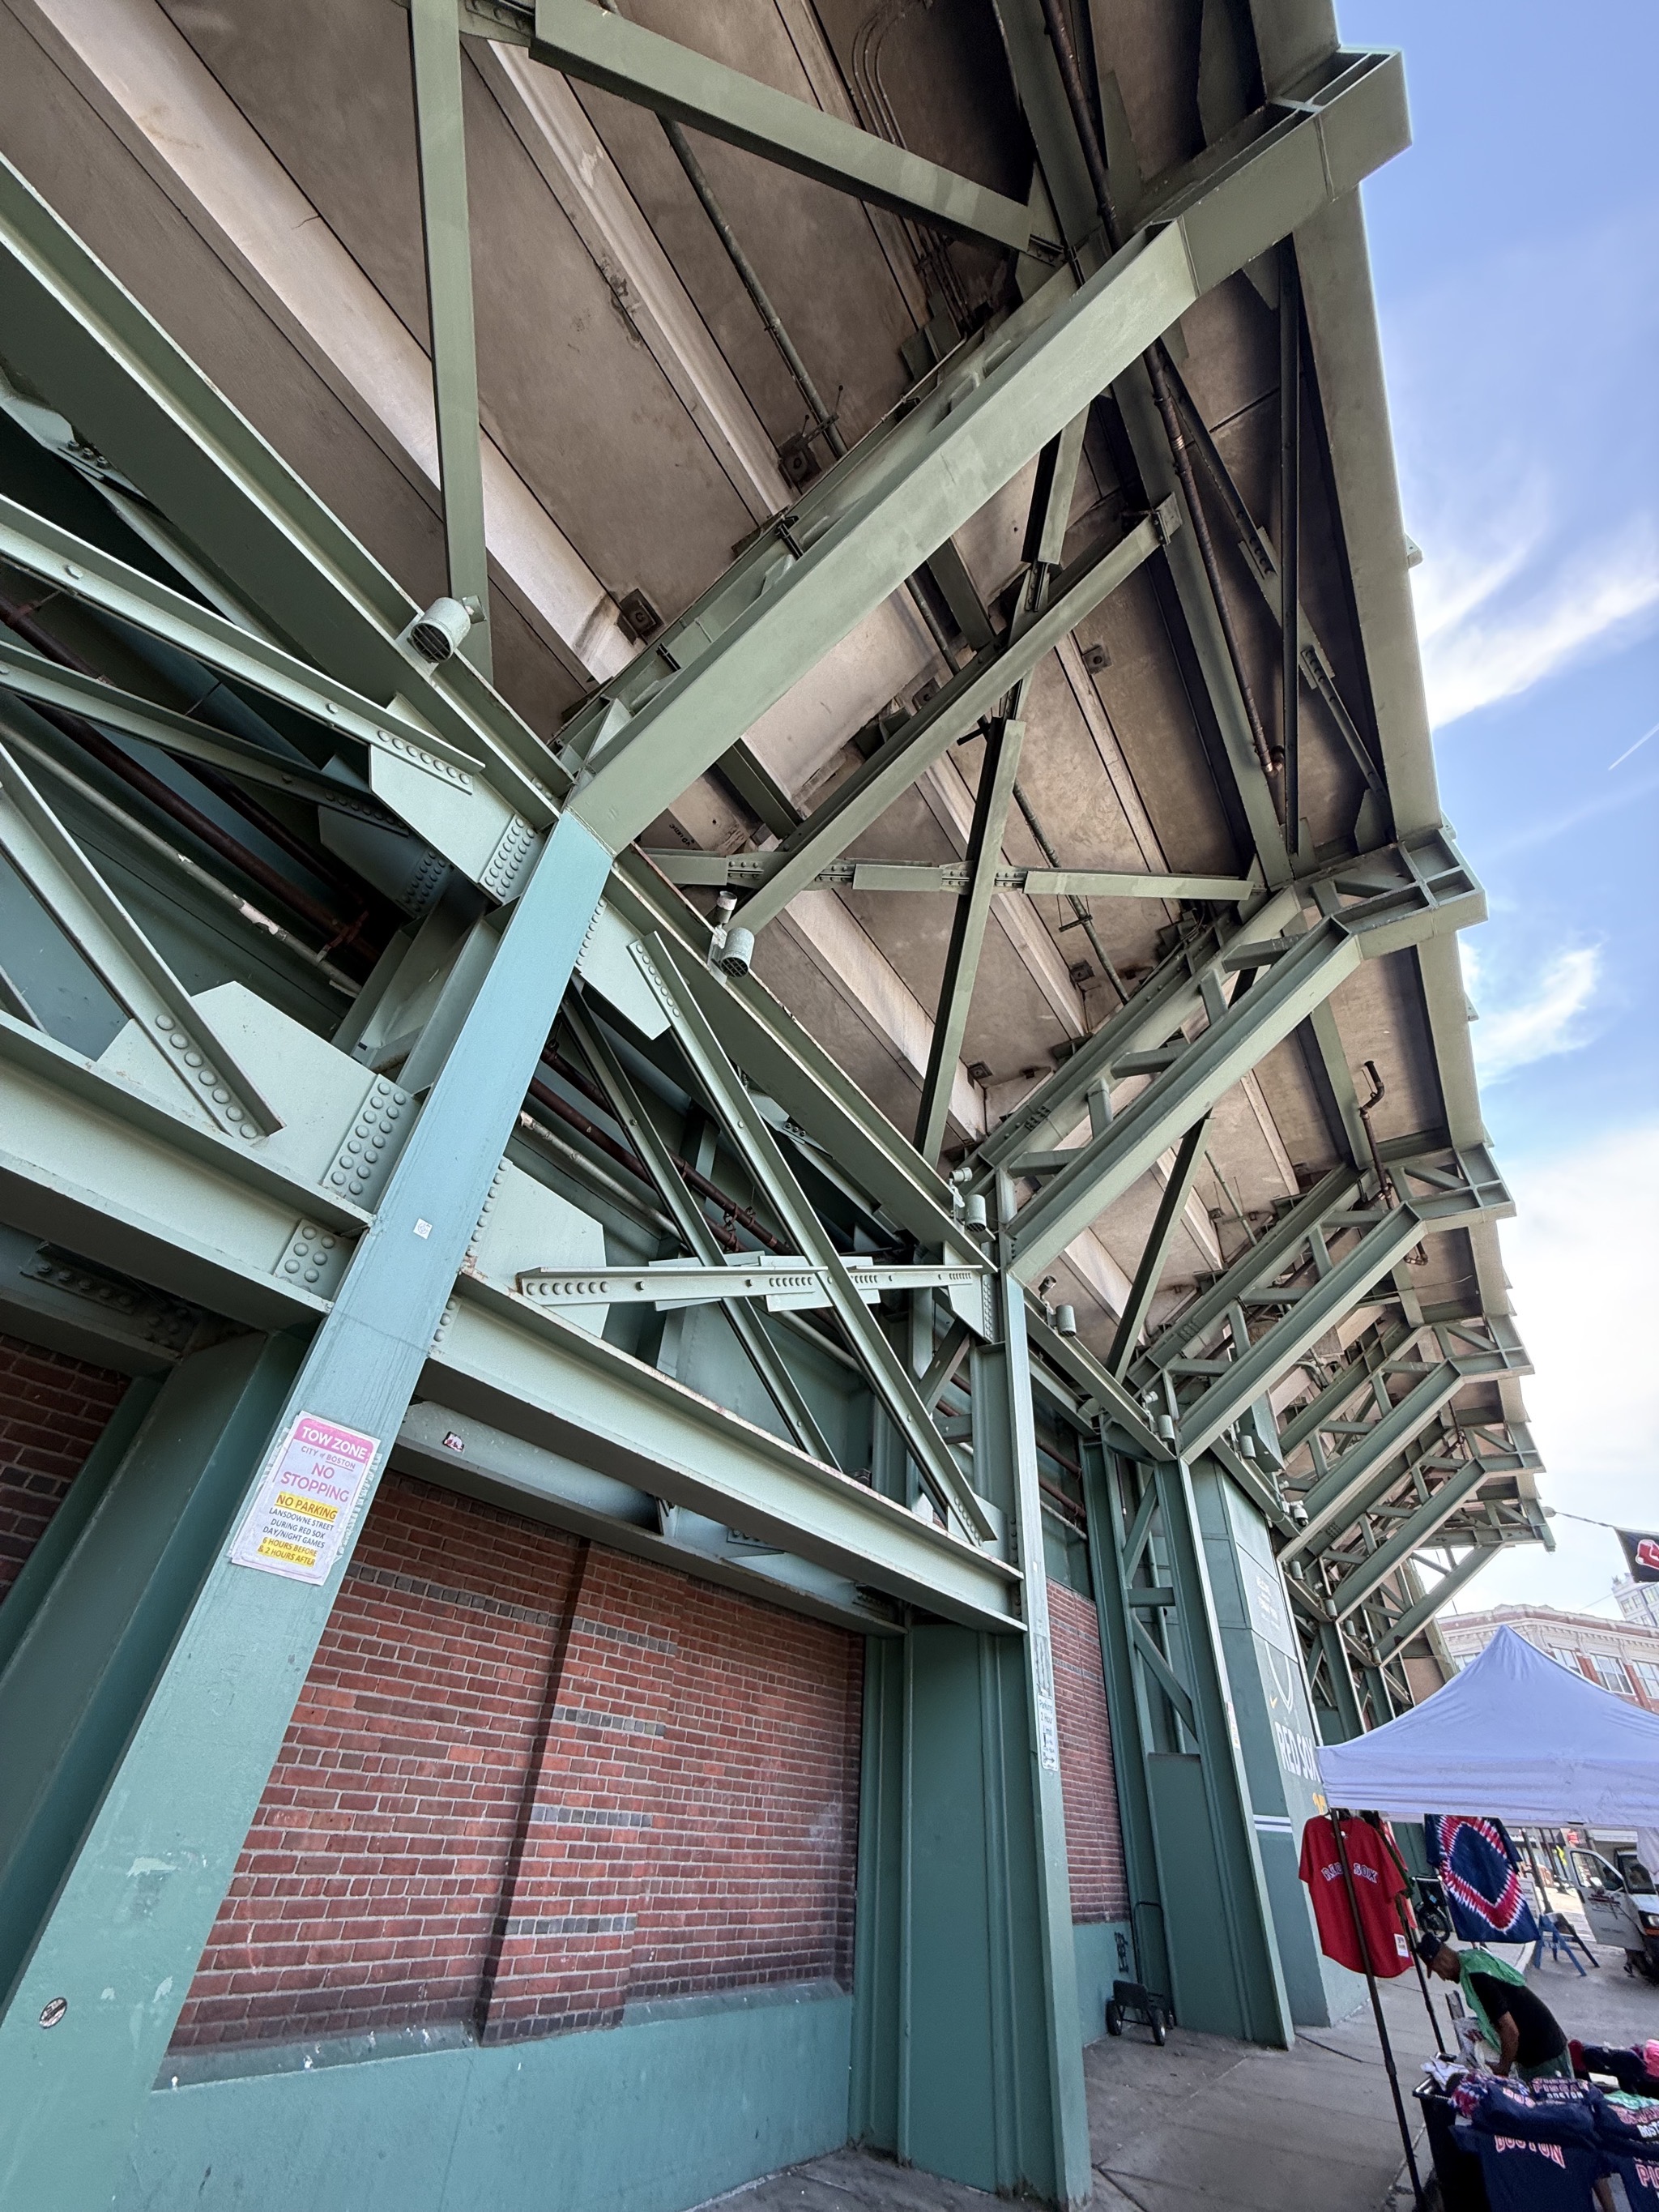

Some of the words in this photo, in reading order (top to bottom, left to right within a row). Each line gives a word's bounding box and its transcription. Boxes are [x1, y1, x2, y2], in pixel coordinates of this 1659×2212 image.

[302, 1427, 332, 1447] TOW
[331, 1438, 368, 1458] ZONE
[301, 1446, 318, 1457] CITY
[326, 1454, 356, 1470] BOSTON
[311, 1463, 335, 1480] NO
[280, 1471, 349, 1502] STOPPING
[276, 1494, 294, 1507] NO
[295, 1499, 338, 1520] PARKING
[269, 1507, 312, 1525] LANSDOWNE
[311, 1519, 335, 1531] STREET
[271, 1518, 298, 1532] DURING
[298, 1526, 311, 1535] RED
[312, 1531, 326, 1539] SOX
[262, 1526, 302, 1542] DAY/NIGHT
[302, 1536, 325, 1548] GAMES
[262, 1536, 268, 1544] 6
[268, 1538, 292, 1550] HOURS
[293, 1544, 318, 1557] BEFORE
[271, 1549, 295, 1561] HOURS
[295, 1555, 316, 1566] AFTER
[1274, 1721, 1301, 1777] RED
[1296, 1733, 1321, 1783] SOX
[1353, 1863, 1378, 1884] SOX
